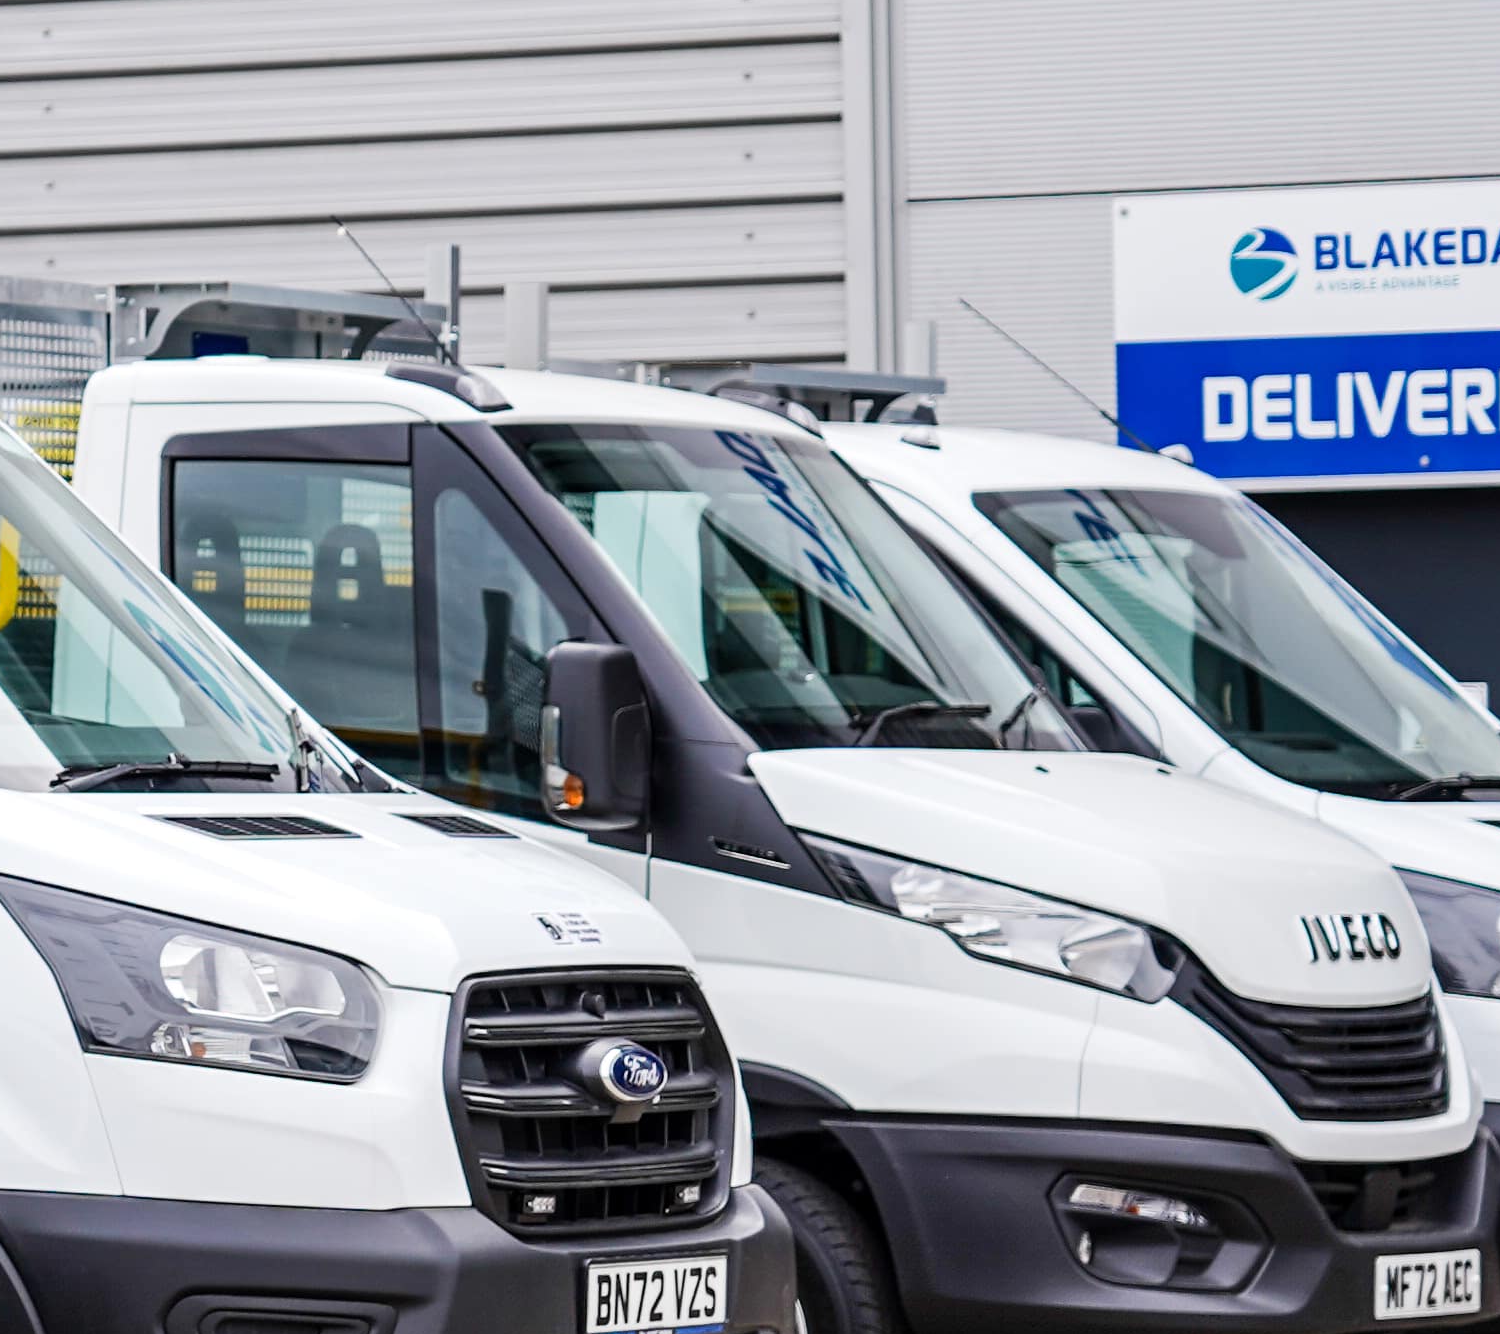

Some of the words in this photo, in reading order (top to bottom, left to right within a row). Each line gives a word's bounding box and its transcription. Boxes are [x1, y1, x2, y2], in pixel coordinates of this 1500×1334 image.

[1315, 279, 1325, 292] A
[1328, 277, 1377, 292] VISIBLE
[1382, 273, 1461, 291] ADVANTAGE
[1297, 913, 1402, 964] IVECO
[623, 1054, 660, 1087] Ford
[596, 1270, 664, 1326] BN72
[674, 1266, 717, 1319] VZS
[1386, 1264, 1437, 1308] MF72
[1443, 1259, 1473, 1304] AEC
